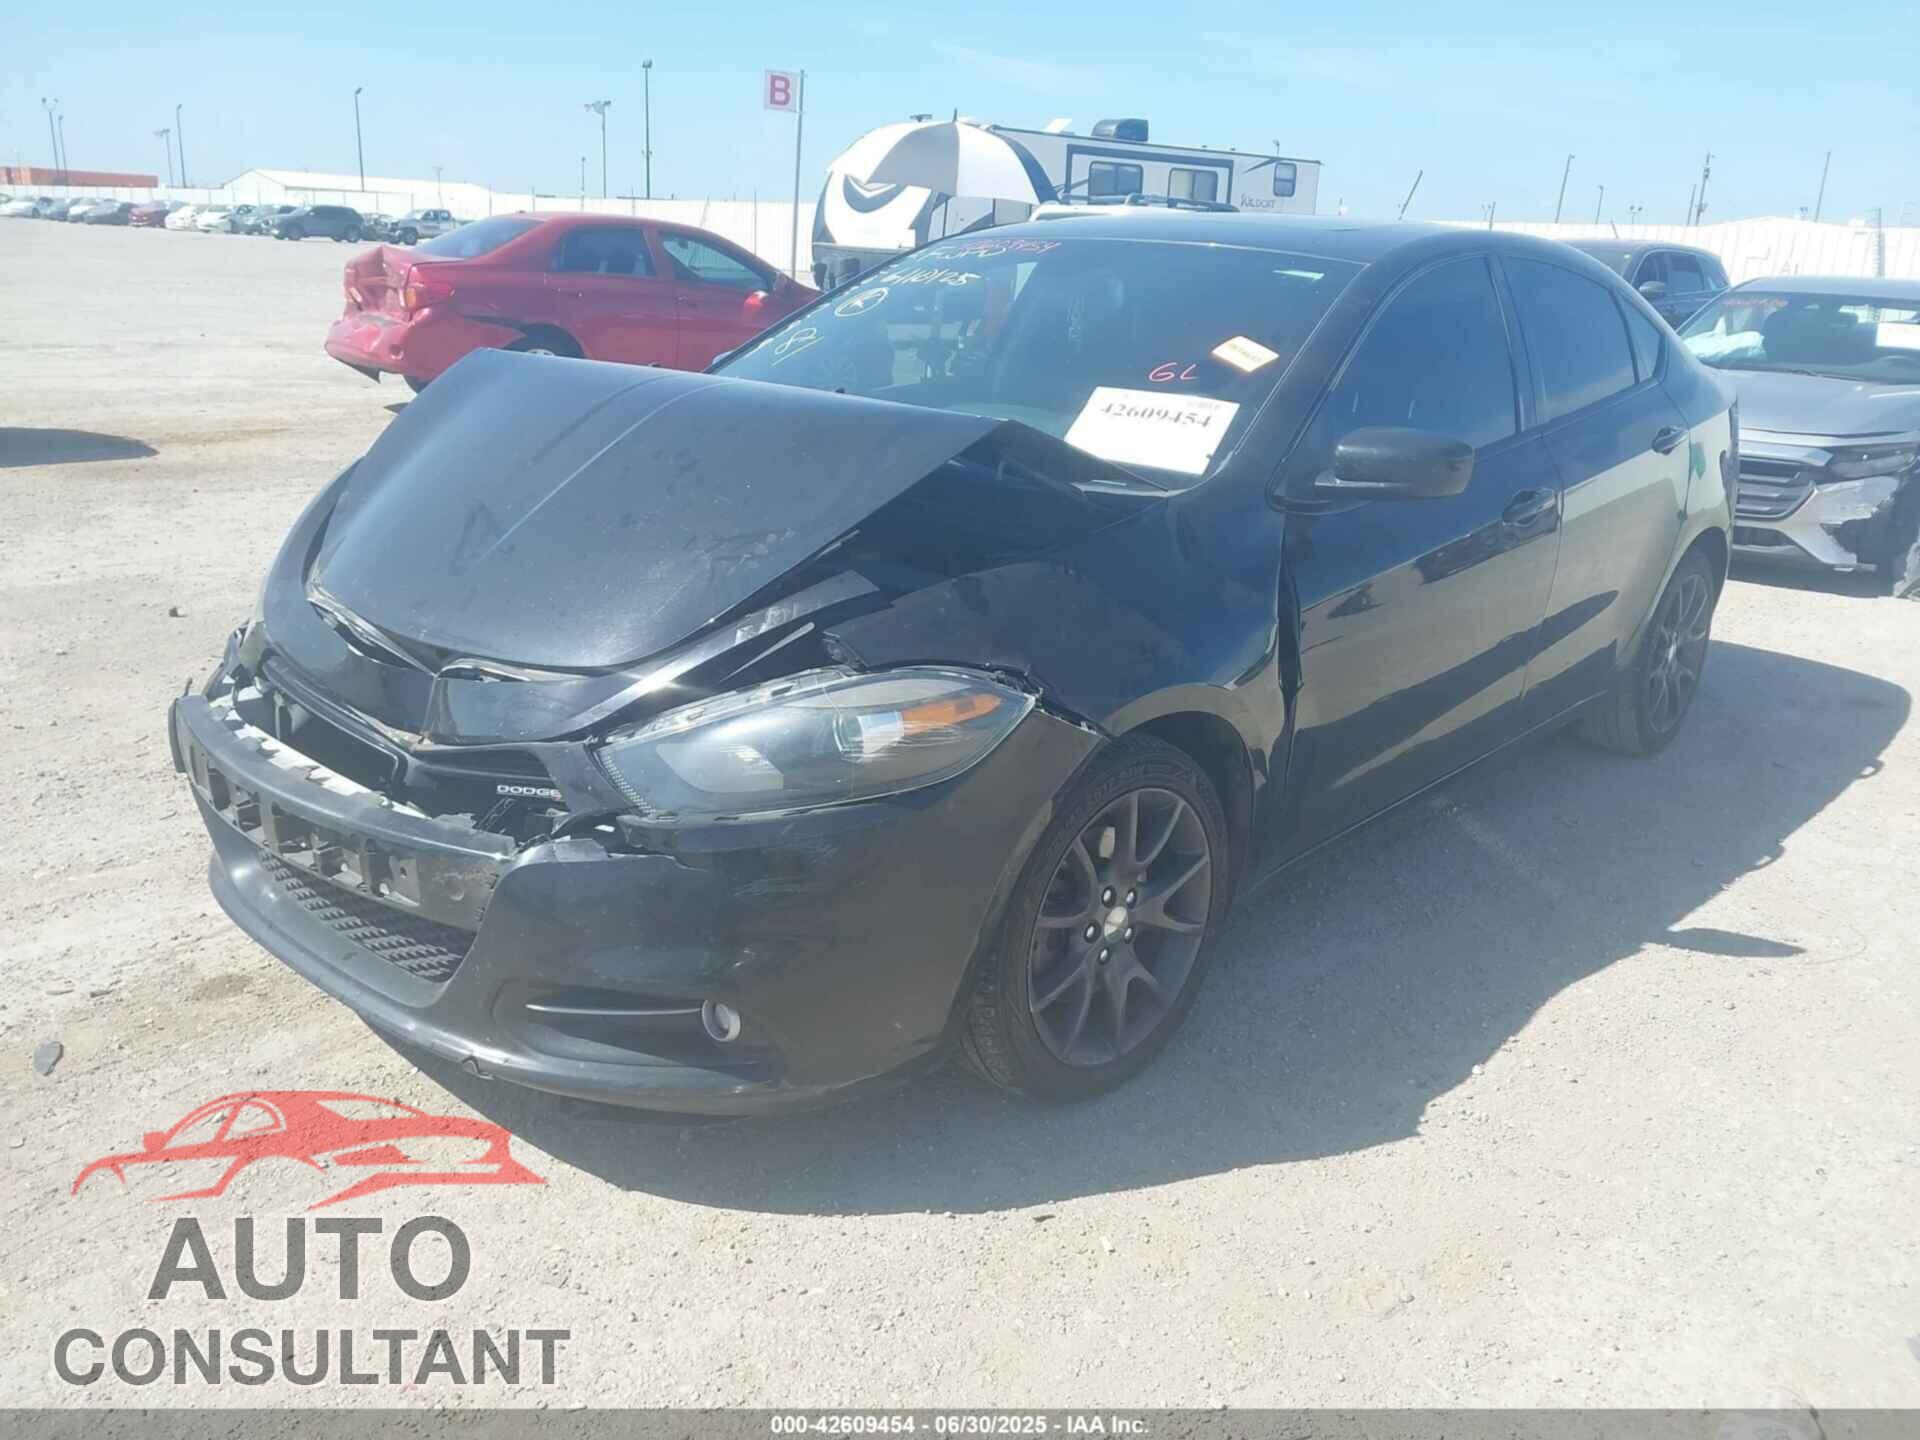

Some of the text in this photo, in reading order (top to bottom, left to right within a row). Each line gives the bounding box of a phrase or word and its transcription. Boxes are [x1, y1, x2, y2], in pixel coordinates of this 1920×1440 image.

[770, 74, 791, 106] B
[1101, 402, 1212, 428] 42609454
[496, 784, 561, 797] DODGE
